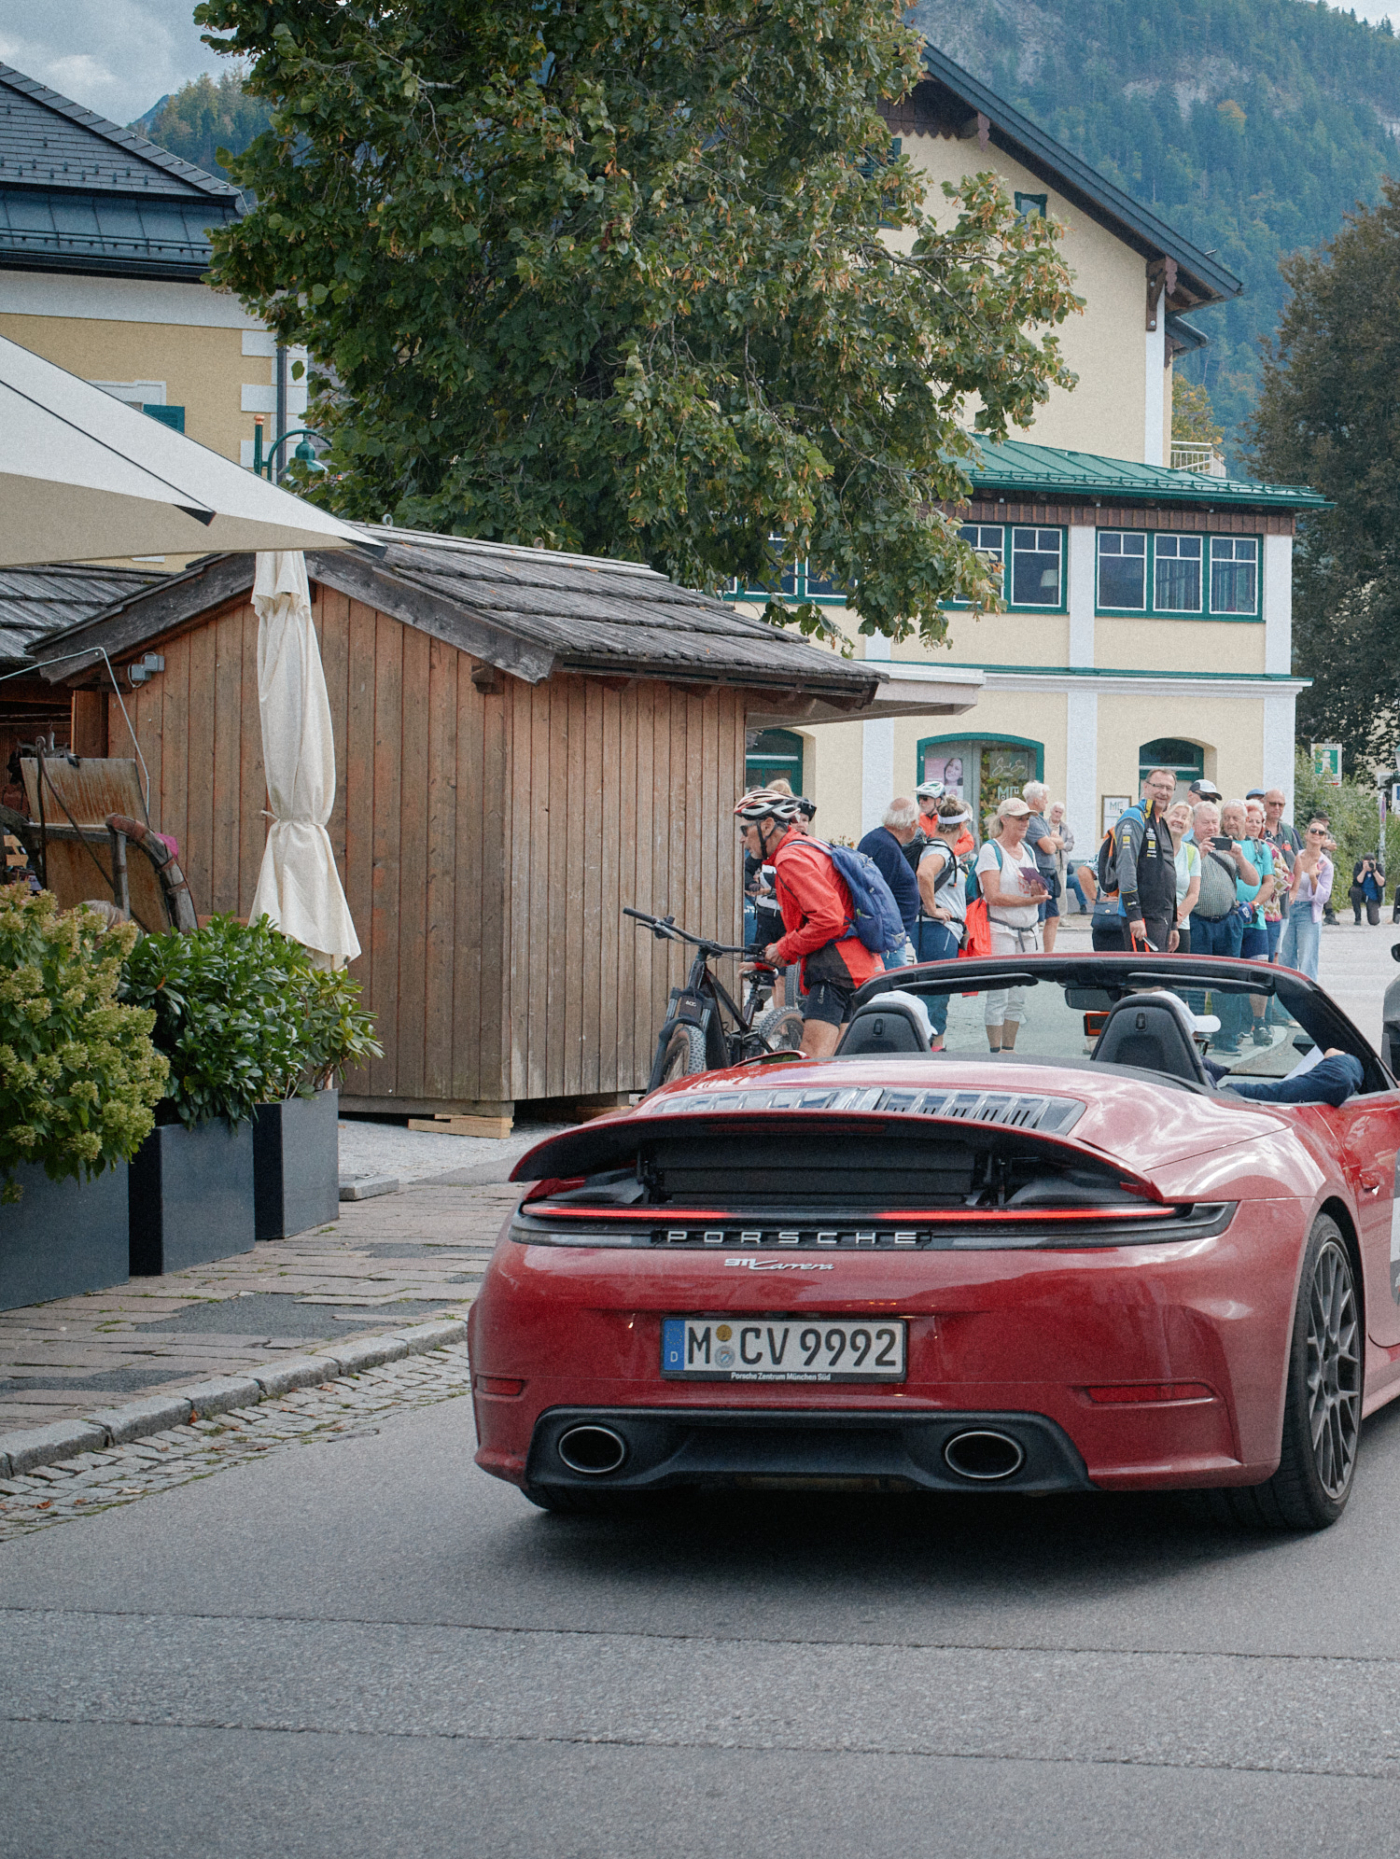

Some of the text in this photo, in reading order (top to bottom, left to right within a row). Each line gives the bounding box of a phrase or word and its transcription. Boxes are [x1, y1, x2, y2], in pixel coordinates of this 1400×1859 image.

[666, 1231, 918, 1244] PORSCHE
[748, 1259, 835, 1270] Carrera
[688, 1327, 897, 1367] M CV 9992
[670, 1351, 678, 1363] D
[731, 1371, 831, 1381] Porsche Zentrum München Süd
